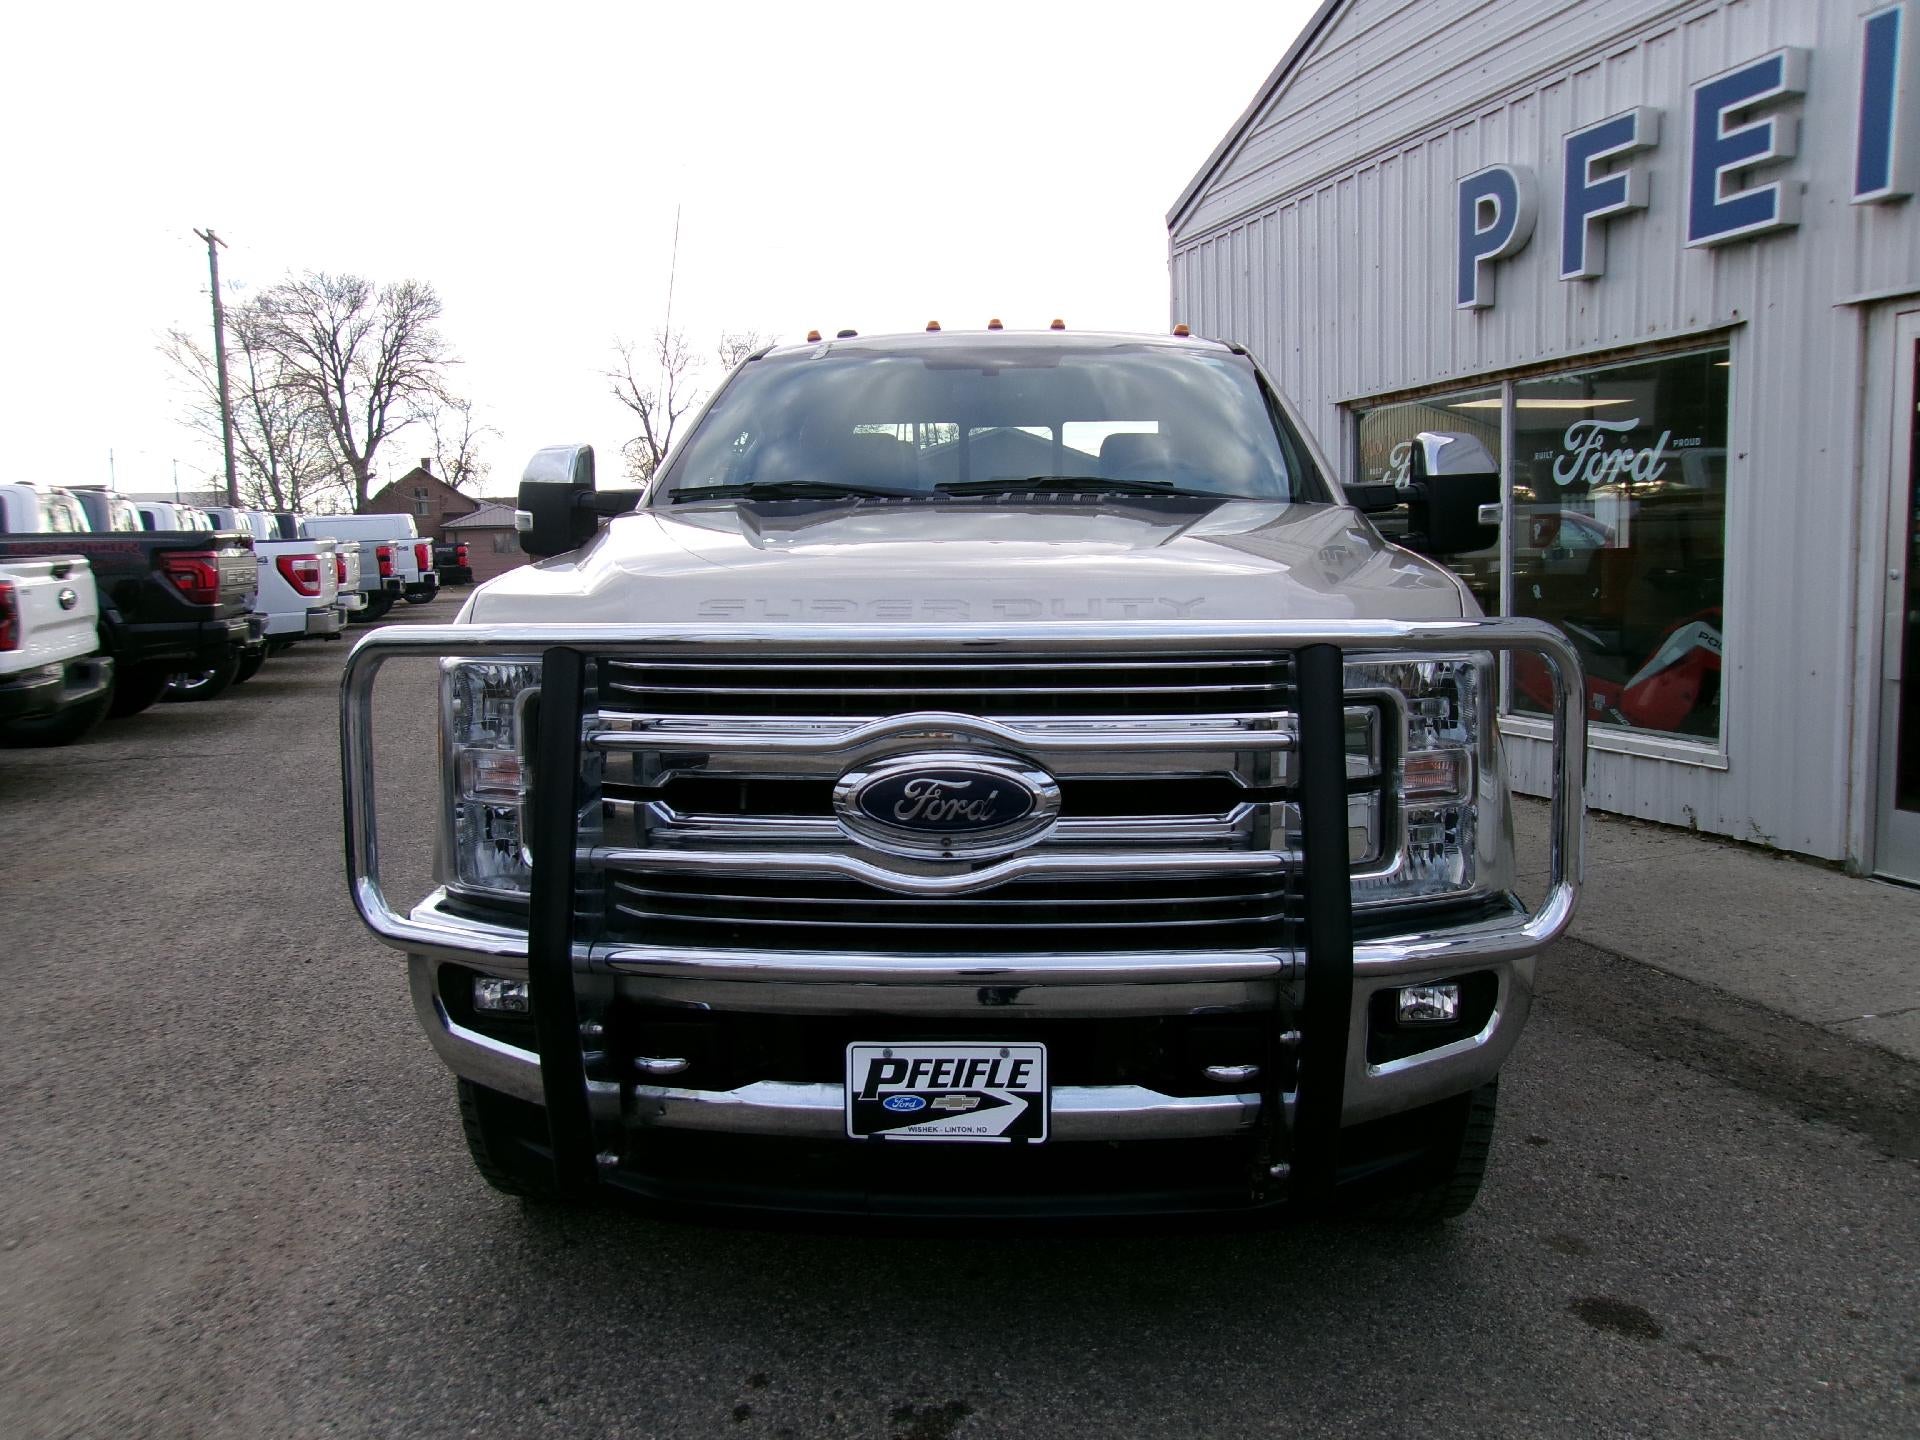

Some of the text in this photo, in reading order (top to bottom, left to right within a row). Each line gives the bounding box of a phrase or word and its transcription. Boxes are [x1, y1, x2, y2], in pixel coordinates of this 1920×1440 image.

[1456, 5, 1908, 310] PFEI
[1552, 417, 1672, 486] Ford
[1672, 437, 1702, 448] PROUD
[697, 596, 1206, 620] SUPER DUTY
[894, 777, 1000, 821] Ford
[858, 1057, 1034, 1101] PFEIFLE
[891, 1096, 917, 1109] Ford
